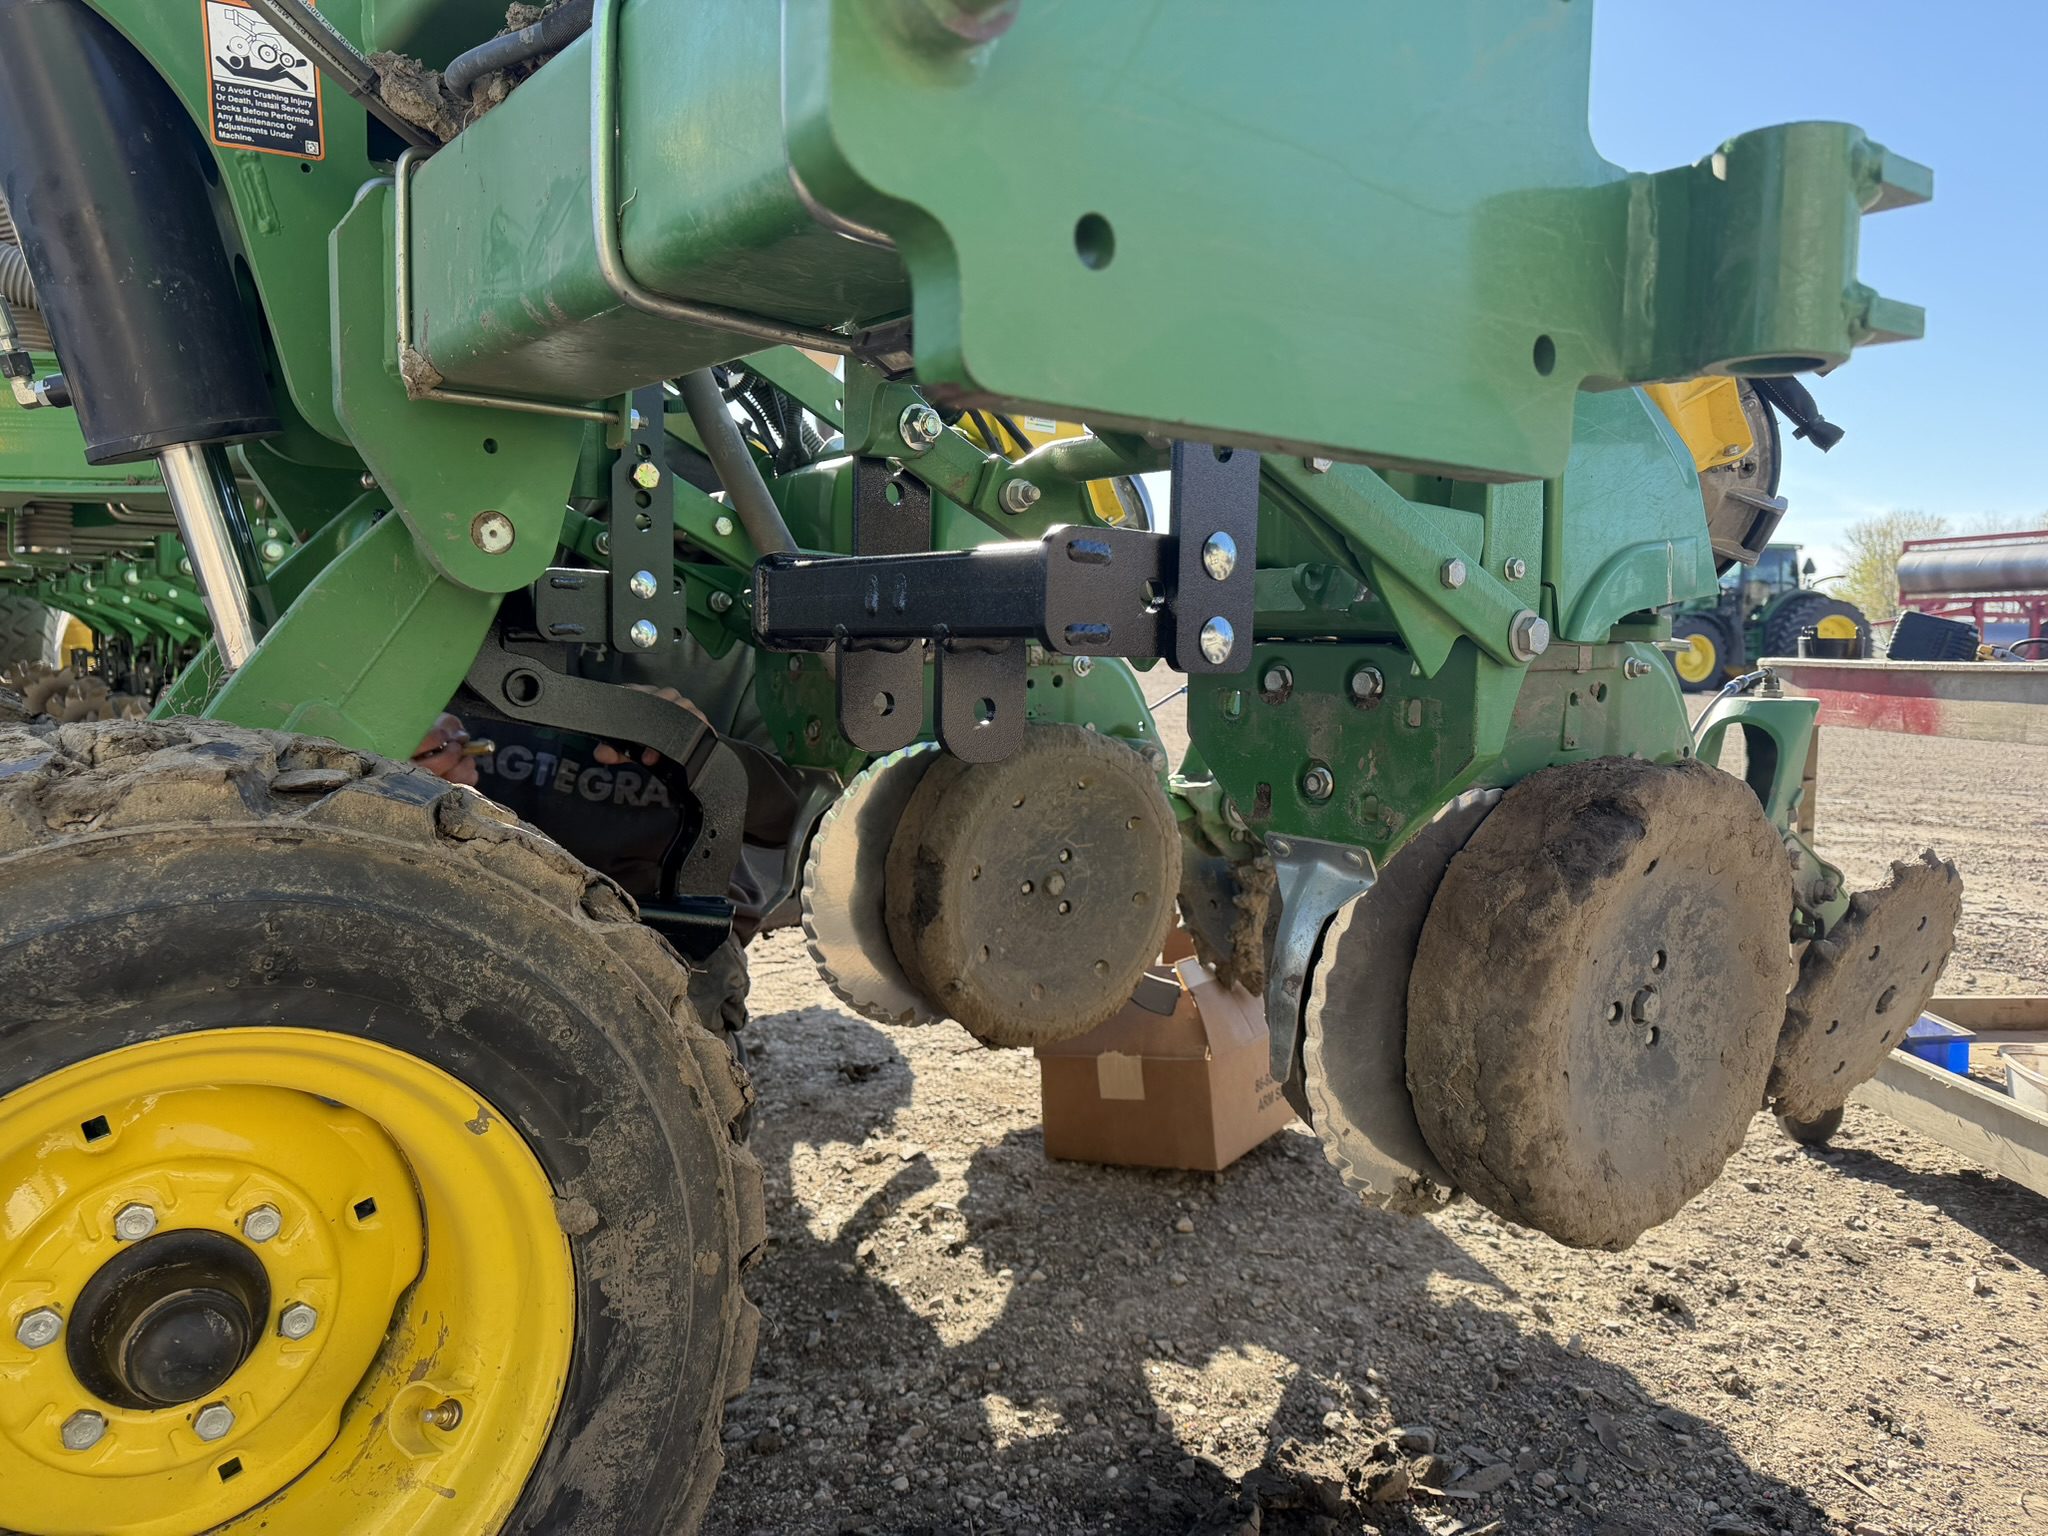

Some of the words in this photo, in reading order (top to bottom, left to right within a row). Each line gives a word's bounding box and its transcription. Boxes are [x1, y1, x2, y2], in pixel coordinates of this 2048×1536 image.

[321, 18, 336, 33] PSI
[215, 83, 226, 92] To
[228, 85, 251, 96] Avoid
[253, 89, 289, 104] Crushing
[290, 96, 312, 108] Injury
[215, 93, 226, 101] Or
[228, 95, 254, 106] Death,
[255, 99, 279, 110] Install
[281, 104, 310, 115] Service
[216, 103, 240, 113] Locks
[243, 106, 269, 117] Before
[271, 111, 314, 126] Performing
[217, 112, 233, 122] Any
[235, 114, 285, 129] Maintenance
[286, 123, 296, 131] Or
[218, 121, 268, 135] Adjustments
[270, 129, 294, 139] Under
[218, 131, 255, 142] Machine.
